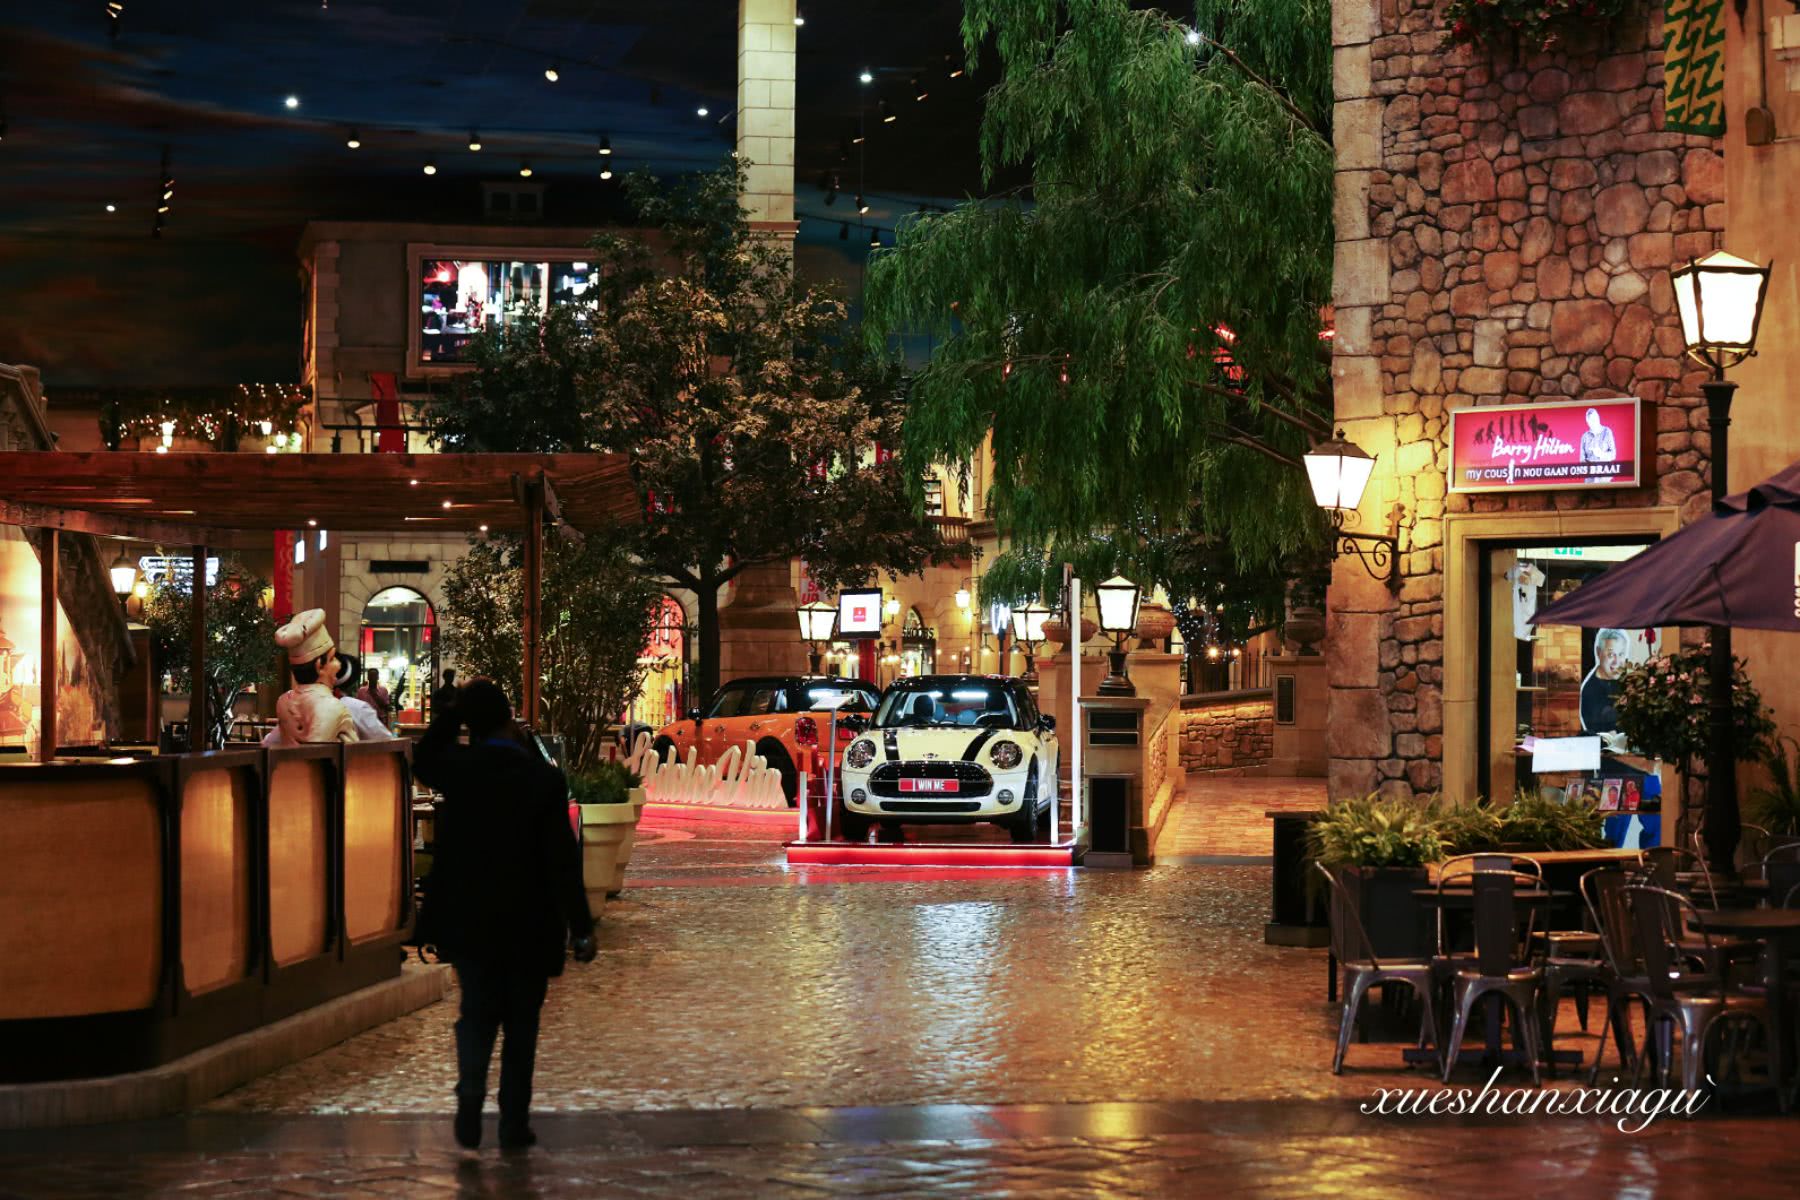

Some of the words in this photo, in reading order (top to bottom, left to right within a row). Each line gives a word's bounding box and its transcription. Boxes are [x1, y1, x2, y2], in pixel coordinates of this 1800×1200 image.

[1491, 435, 1533, 463] Barry
[1533, 433, 1575, 461] Hilton
[1466, 469, 1482, 481] my
[1523, 467, 1542, 477] NOU
[1543, 466, 1568, 476] GAAN
[1570, 465, 1588, 475] ONS
[1590, 464, 1621, 474] BRAAI
[918, 779, 932, 790] WIN
[933, 779, 945, 790] ME
